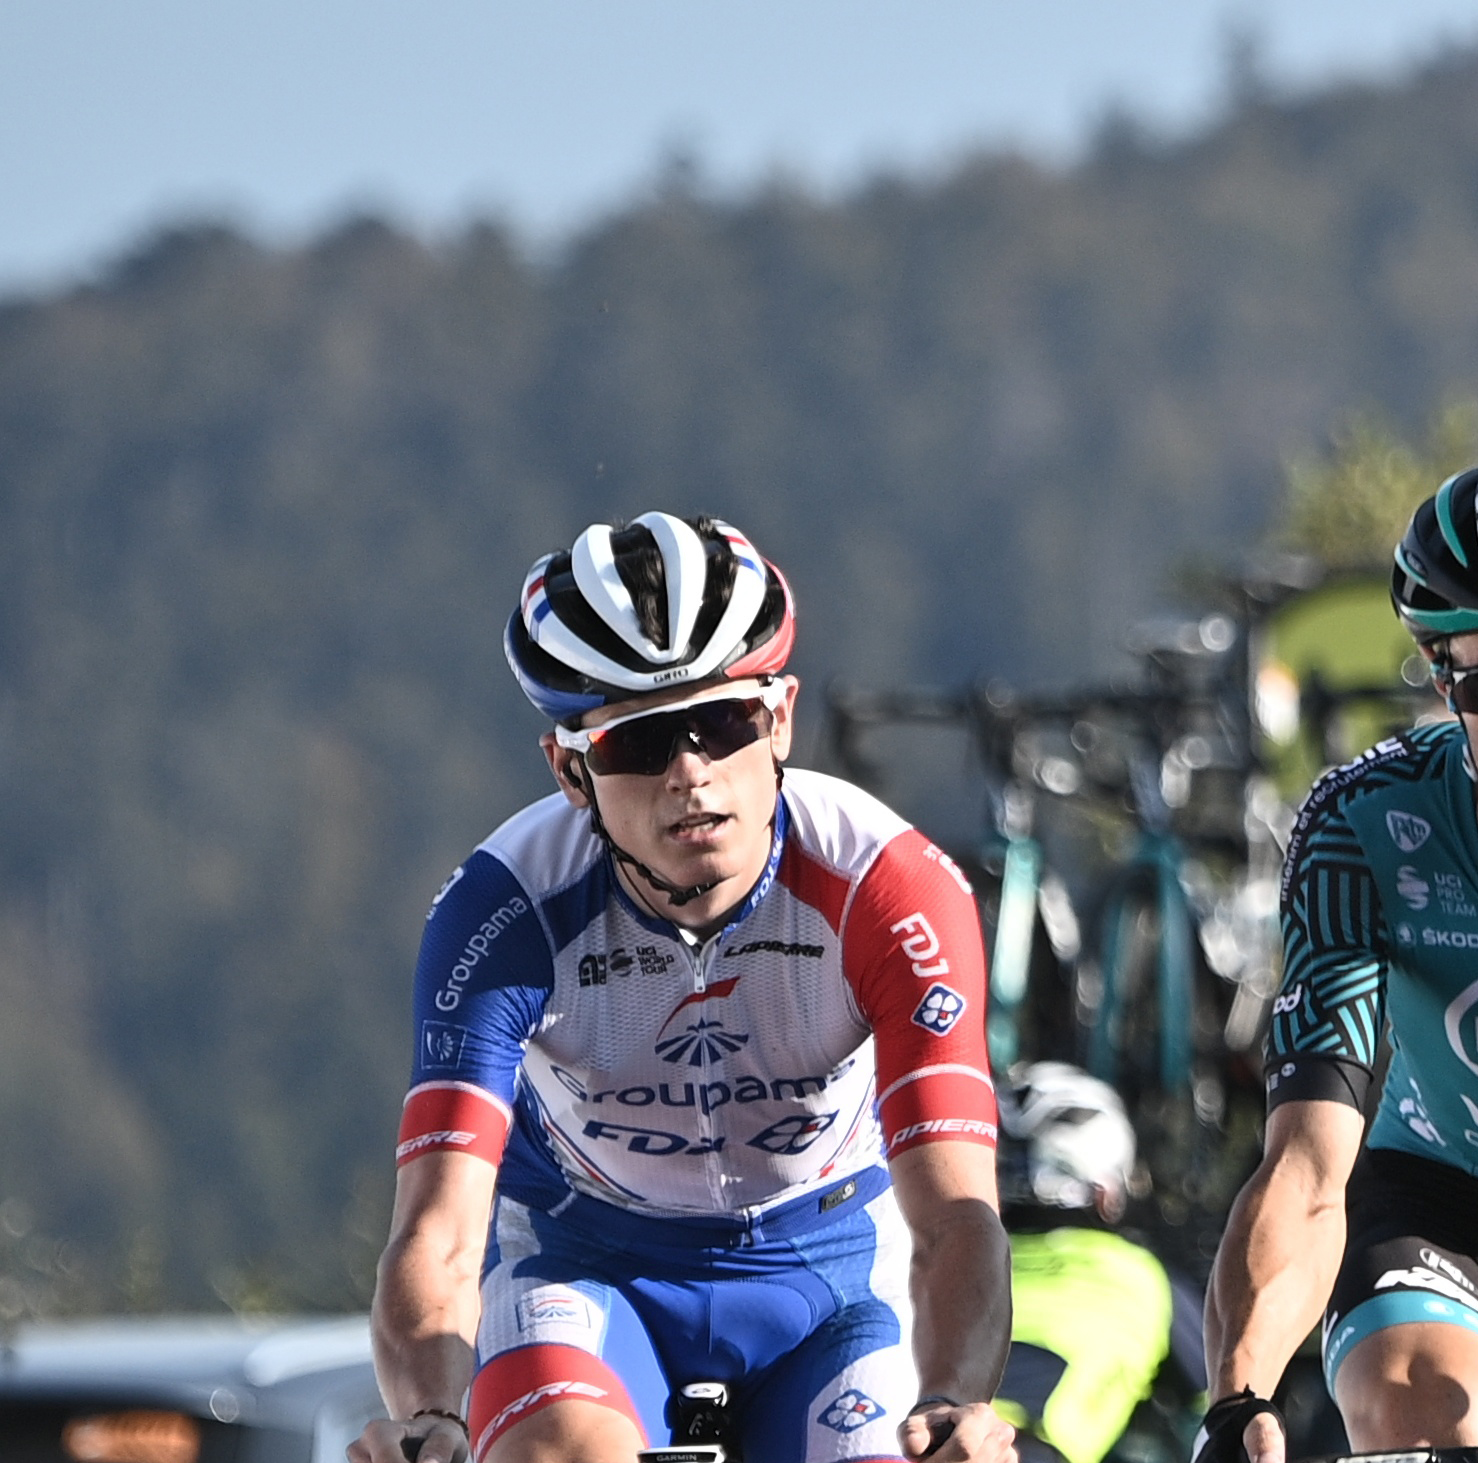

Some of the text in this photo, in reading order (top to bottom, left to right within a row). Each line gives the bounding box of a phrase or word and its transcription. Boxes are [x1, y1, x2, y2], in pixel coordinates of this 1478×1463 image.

[1433, 872, 1462, 887] UCI
[1436, 887, 1465, 901] PRO
[1440, 901, 1476, 918] TEAM
[890, 912, 949, 978] FDJ
[435, 897, 527, 1012] Groupama
[550, 1059, 855, 1115] Groupama
[656, 1453, 697, 1463] GARMIN
